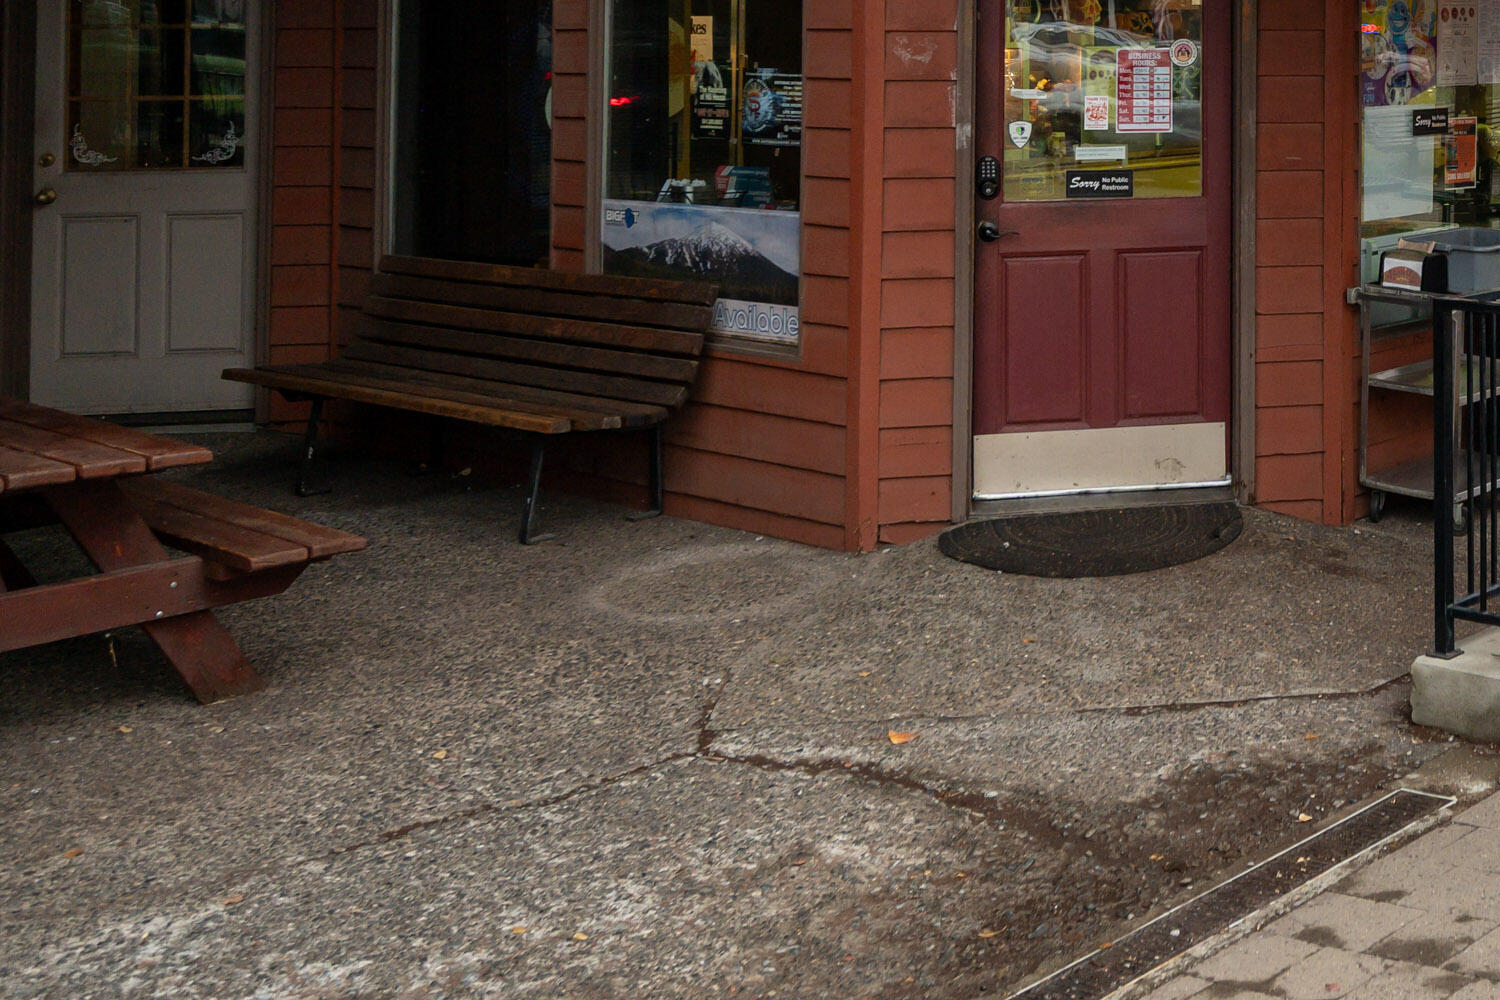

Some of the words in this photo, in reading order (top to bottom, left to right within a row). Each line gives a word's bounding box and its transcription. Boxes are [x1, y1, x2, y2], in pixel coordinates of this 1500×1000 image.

[1415, 115, 1431, 127] Sorry
[1069, 176, 1100, 190] Sorry
[713, 301, 799, 336] Available
